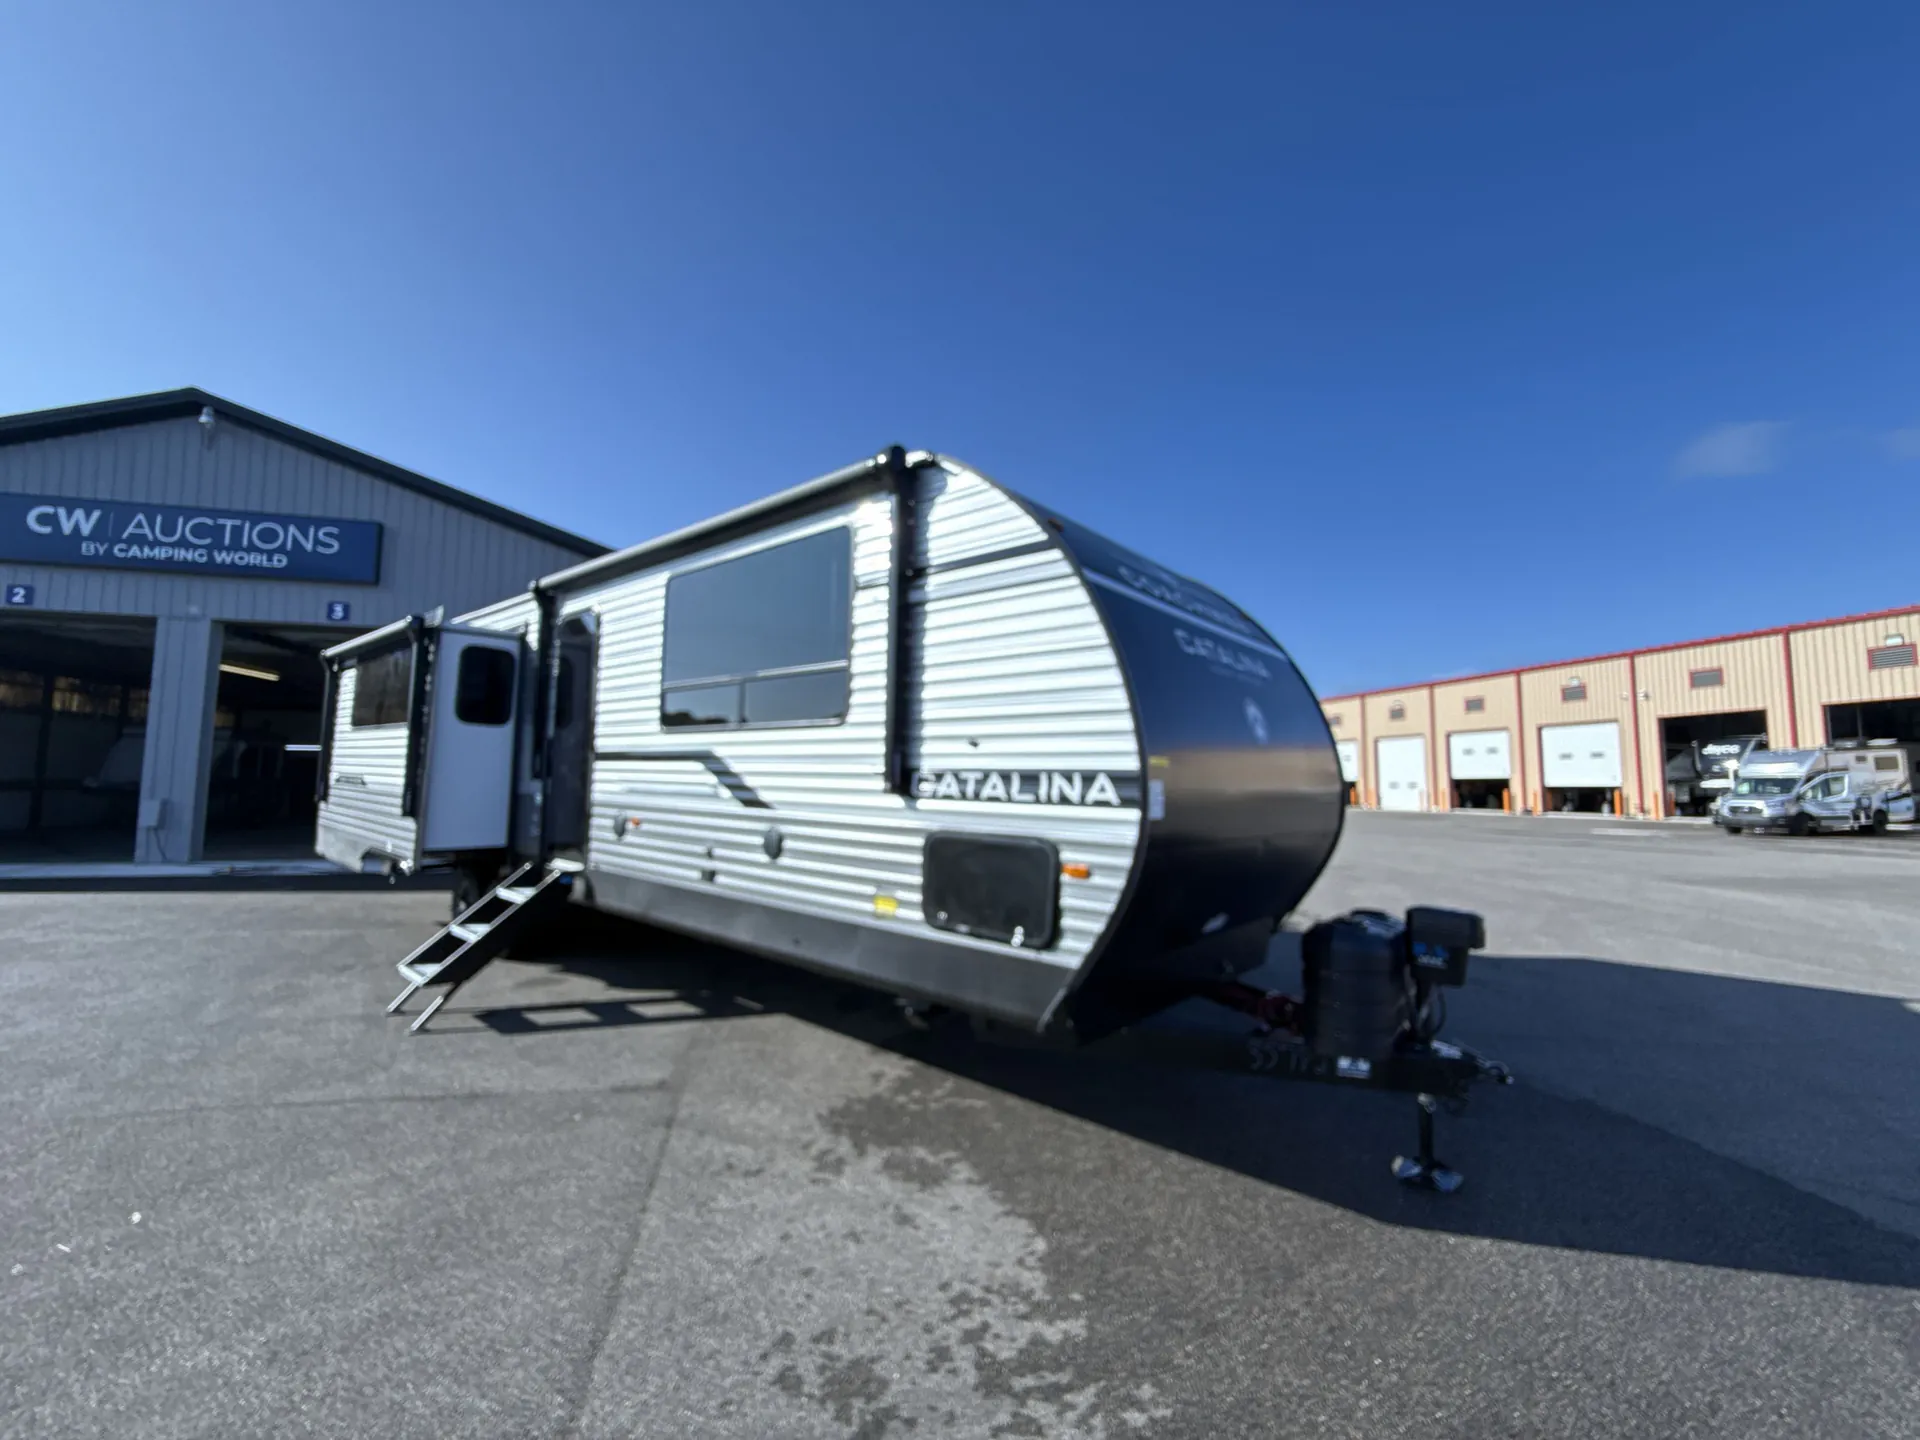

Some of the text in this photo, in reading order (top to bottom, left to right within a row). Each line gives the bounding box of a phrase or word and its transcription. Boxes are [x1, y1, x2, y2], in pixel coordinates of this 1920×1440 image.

[26, 505, 341, 554] CW AUCTIONS
[81, 541, 288, 568] BY CAMPING WORLD
[12, 587, 26, 603] 2
[330, 603, 344, 620] 3
[910, 770, 1122, 806] CATALINA
